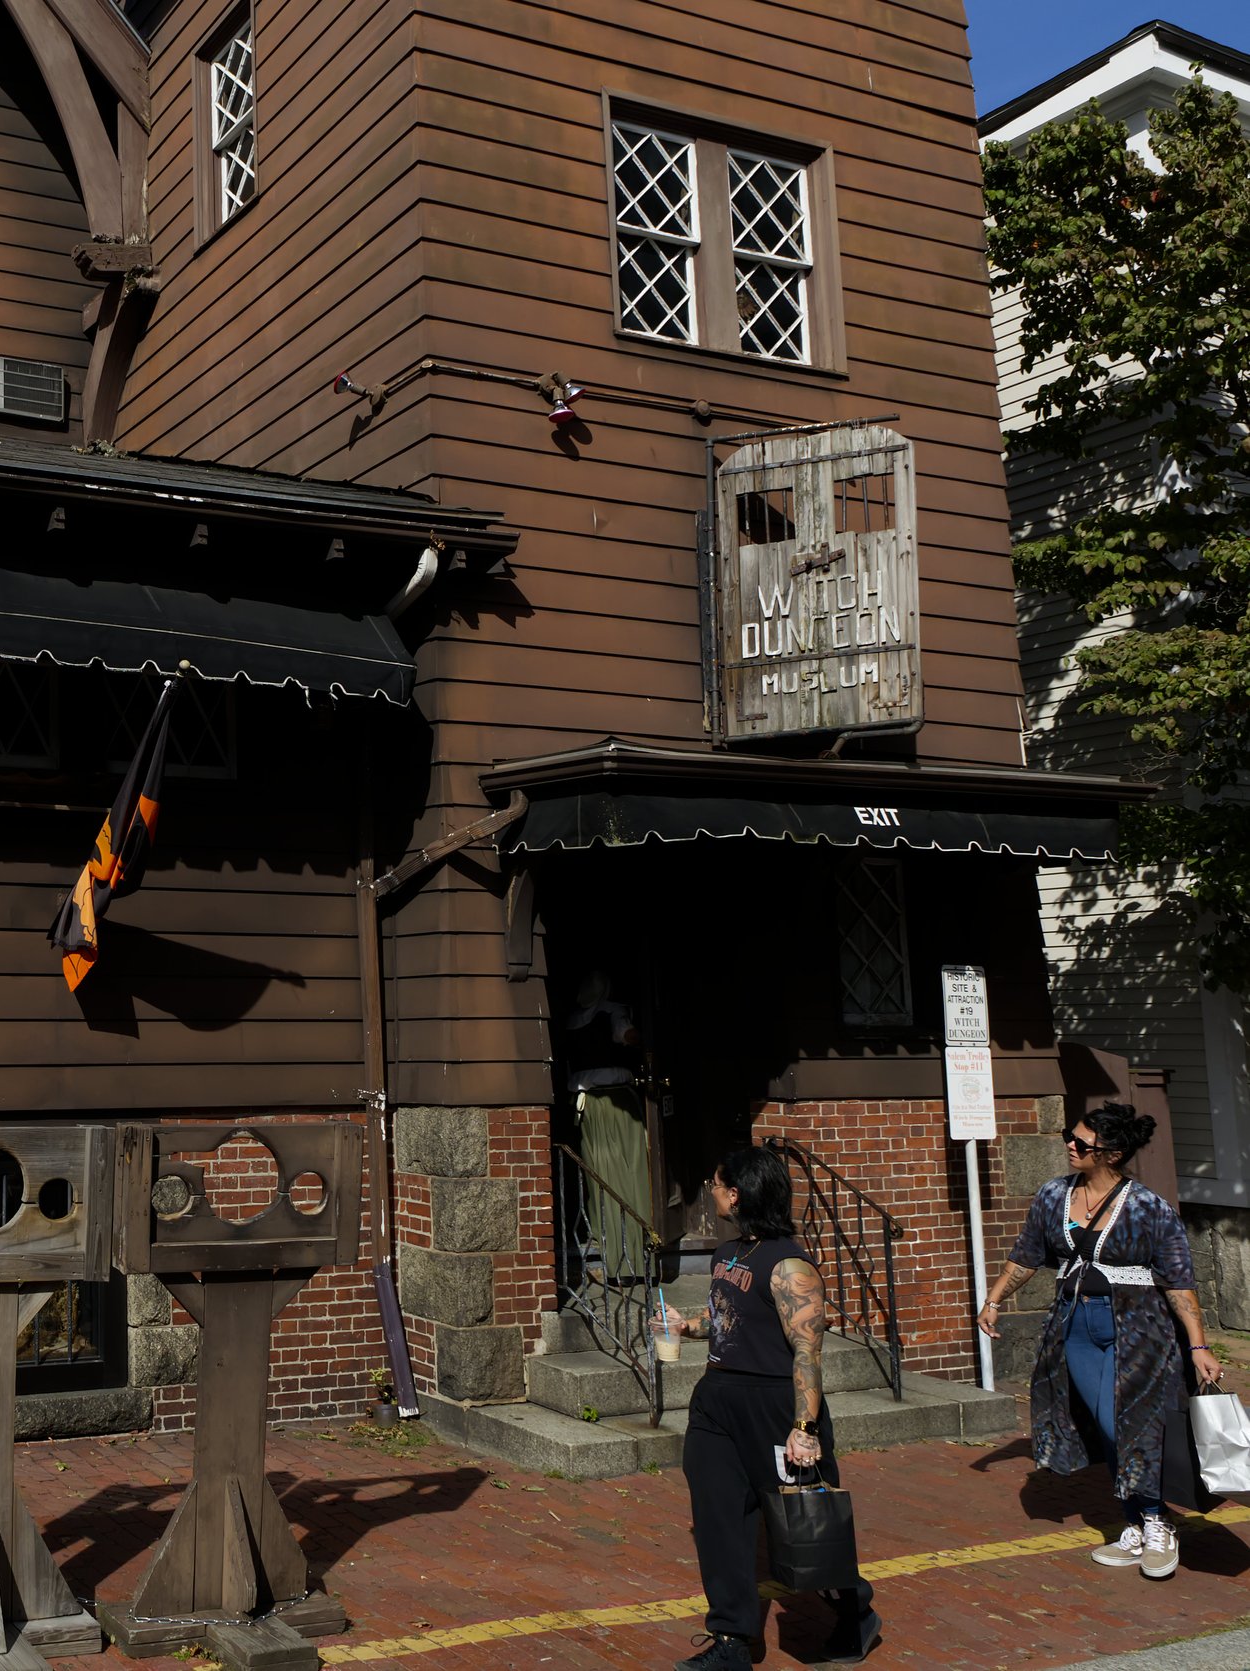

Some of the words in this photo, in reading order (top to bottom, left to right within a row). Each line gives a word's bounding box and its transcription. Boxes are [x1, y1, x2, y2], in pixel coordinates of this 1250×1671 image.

[758, 570, 882, 620] WTCH
[853, 807, 901, 826] EXIT
[947, 972, 980, 981] HISTORIC
[952, 984, 968, 993] SITE
[972, 985, 977, 993] &
[947, 995, 984, 1004] ATTRACTION
[960, 1007, 973, 1015] #19
[954, 1018, 980, 1027] WITCH
[949, 1029, 986, 1038] DUNGEON
[967, 1052, 989, 1062] Trolley
[954, 1063, 969, 1072] Stop
